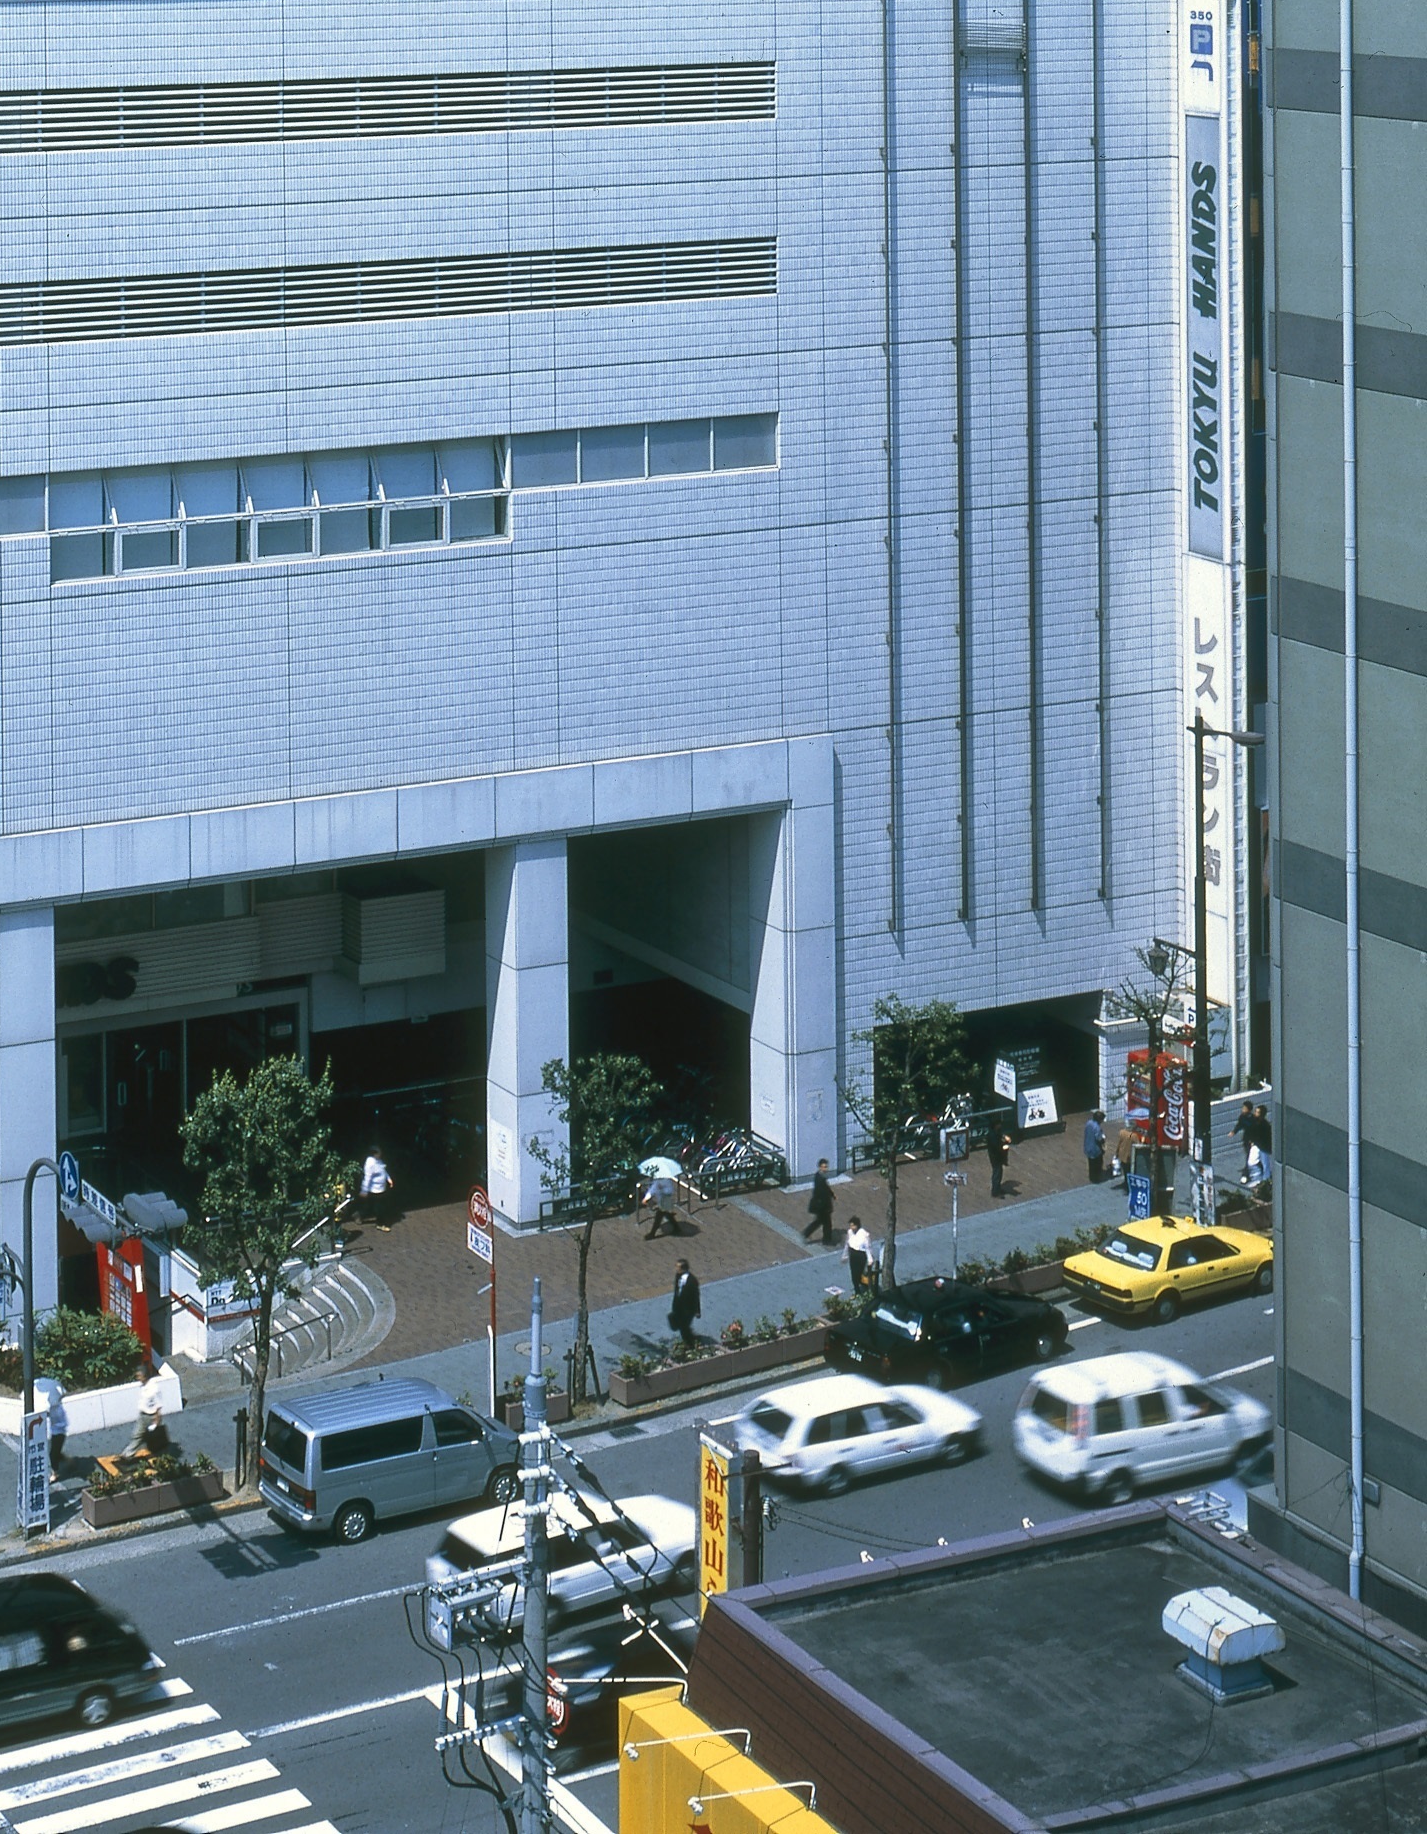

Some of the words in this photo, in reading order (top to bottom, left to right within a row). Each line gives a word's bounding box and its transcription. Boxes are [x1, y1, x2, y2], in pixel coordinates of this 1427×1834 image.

[1190, 10, 1213, 21] 350
[1192, 29, 1211, 51] P
[1192, 161, 1217, 320] HANDS
[1193, 357, 1219, 513] TOKYU
[1136, 1191, 1147, 1206] 50
[29, 1455, 45, 1513] 駐輪場
